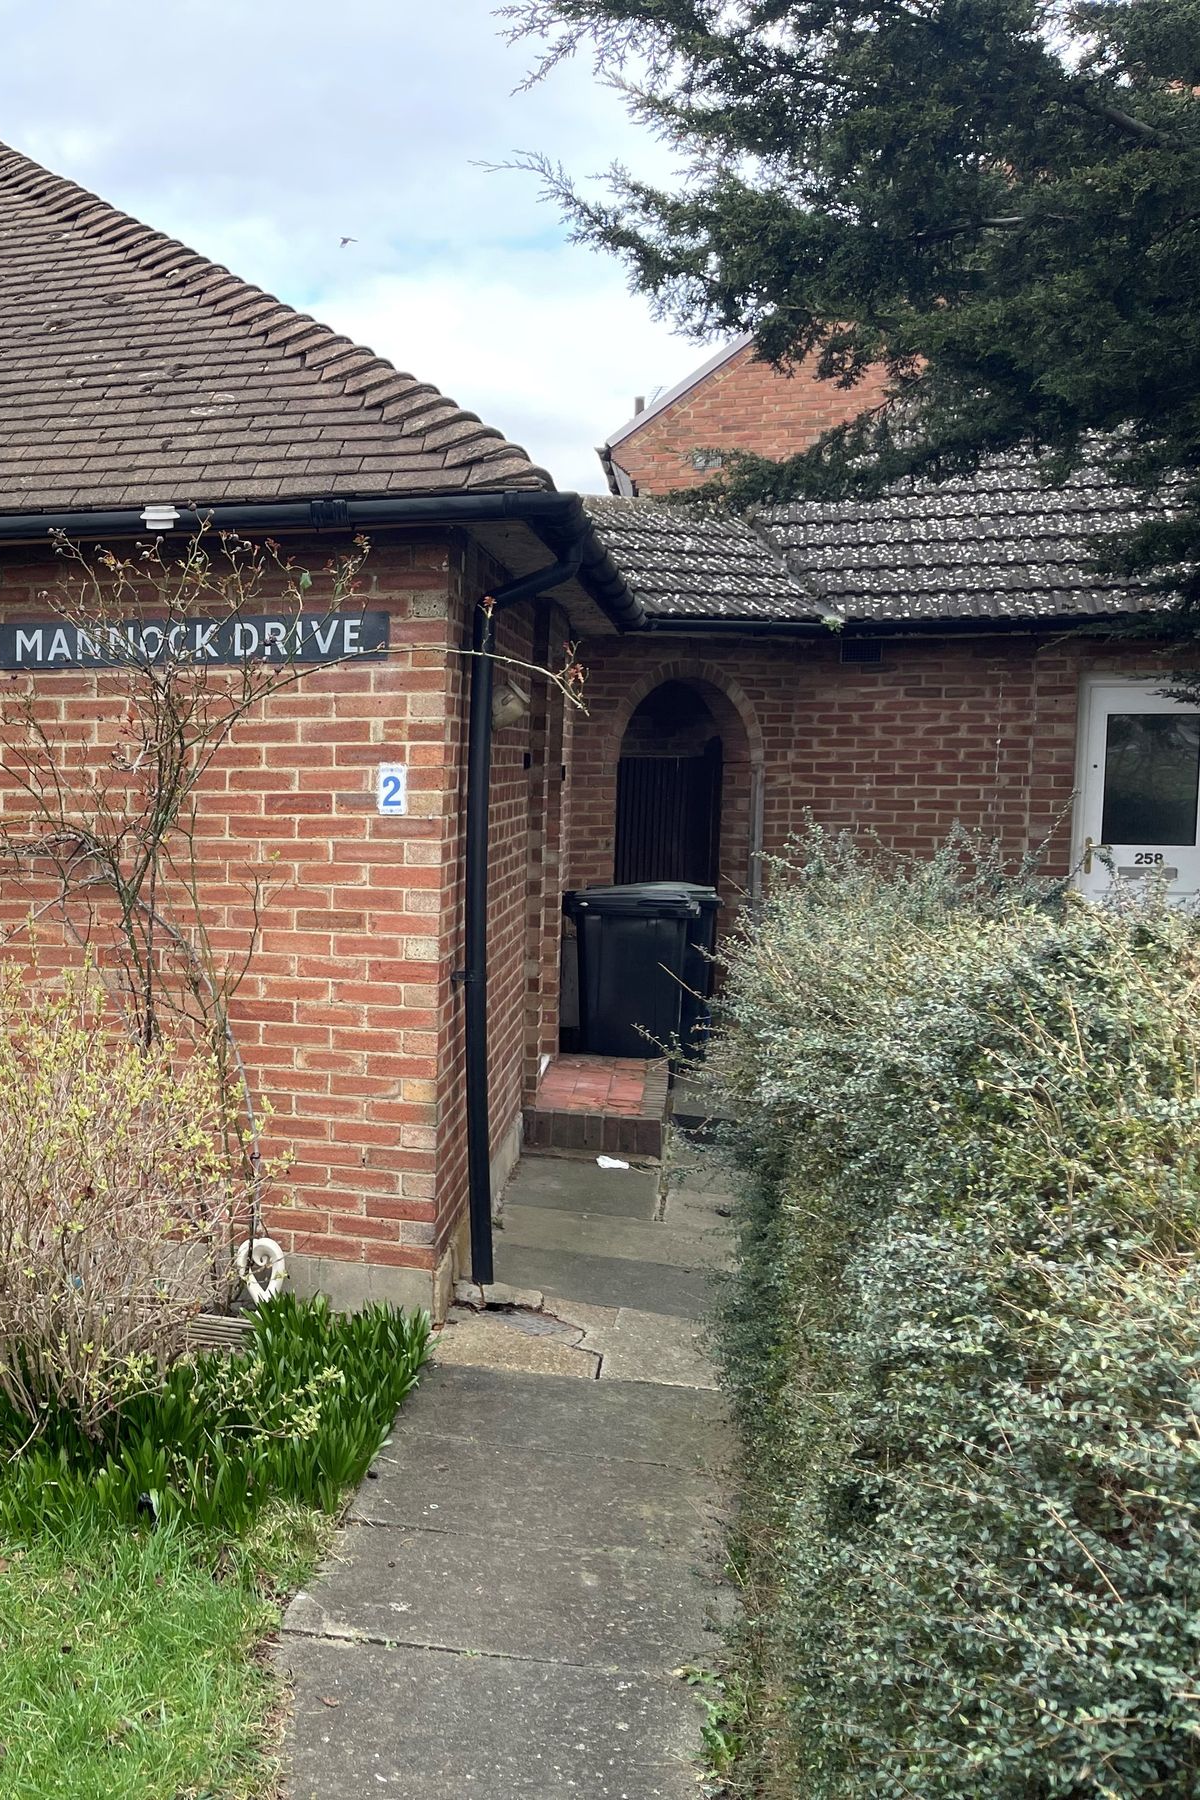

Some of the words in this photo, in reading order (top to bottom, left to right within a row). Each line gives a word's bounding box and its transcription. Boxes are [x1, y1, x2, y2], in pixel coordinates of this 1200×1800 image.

[15, 623, 219, 662] MANNOCK
[233, 618, 364, 657] DRIVE
[383, 776, 401, 806] 2
[1134, 853, 1164, 865] 258
